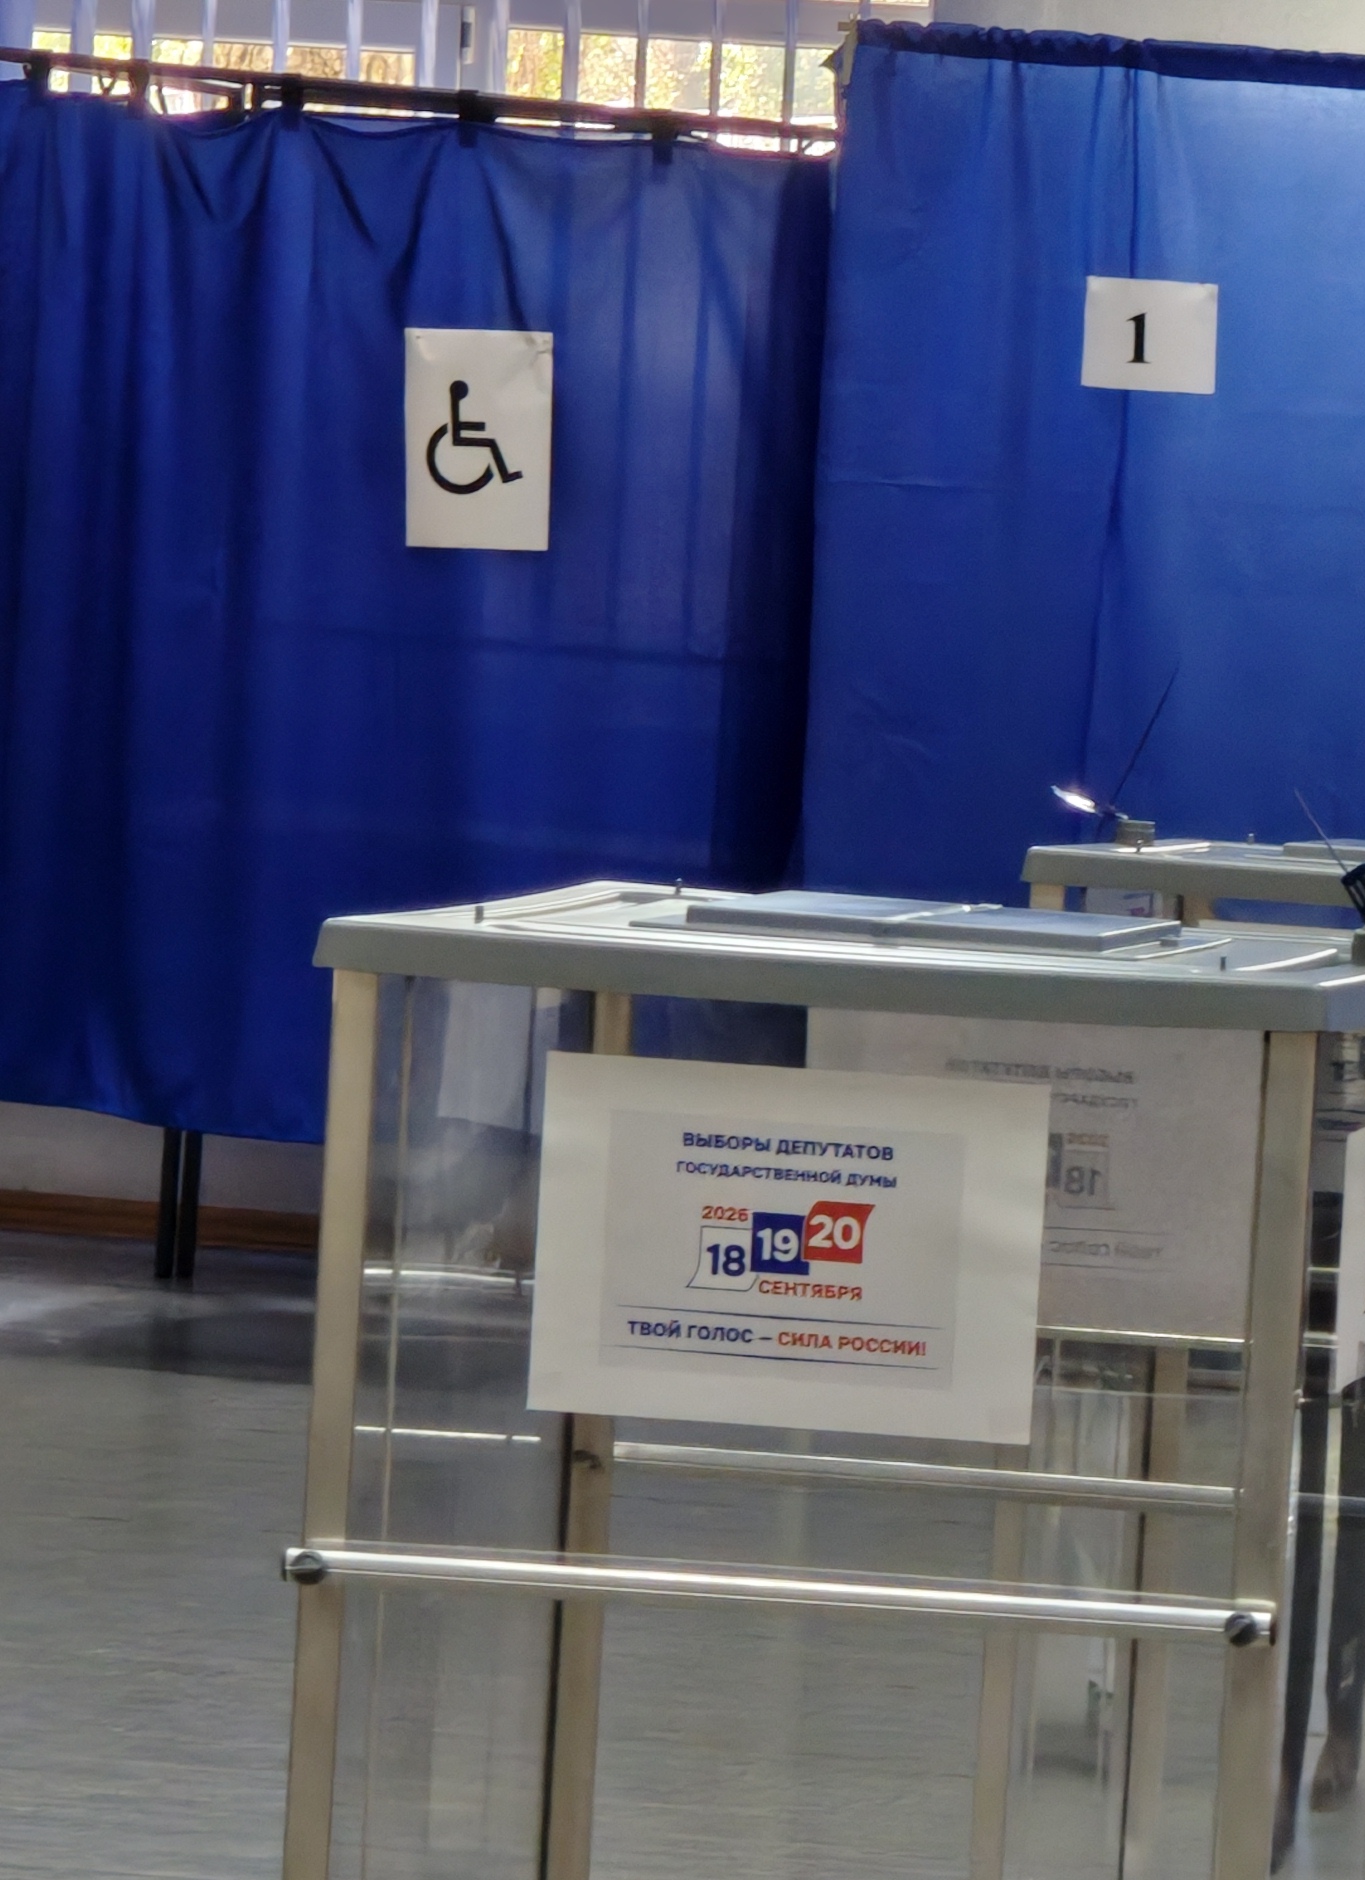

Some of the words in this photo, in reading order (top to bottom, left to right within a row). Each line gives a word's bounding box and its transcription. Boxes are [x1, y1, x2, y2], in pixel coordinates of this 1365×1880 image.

[1126, 312, 1151, 364] 1
[683, 1132, 771, 1152] ВЫБОРЫ
[775, 1138, 894, 1161] ДЕПУТАТОВ
[676, 1160, 842, 1185] ГОСУДАРСТВЕННОЙ
[844, 1172, 898, 1189] ДУМЫ
[702, 1205, 749, 1222] 2026
[706, 1243, 746, 1277] 18
[756, 1227, 799, 1263] 19
[808, 1214, 861, 1250] 20
[758, 1279, 863, 1301] СЕНТЯБРЯ
[627, 1319, 682, 1339] ТВОЙ
[687, 1324, 754, 1344] ГОЛОС
[777, 1330, 833, 1350] СИЛА
[838, 1335, 927, 1357] РОССИИ!
